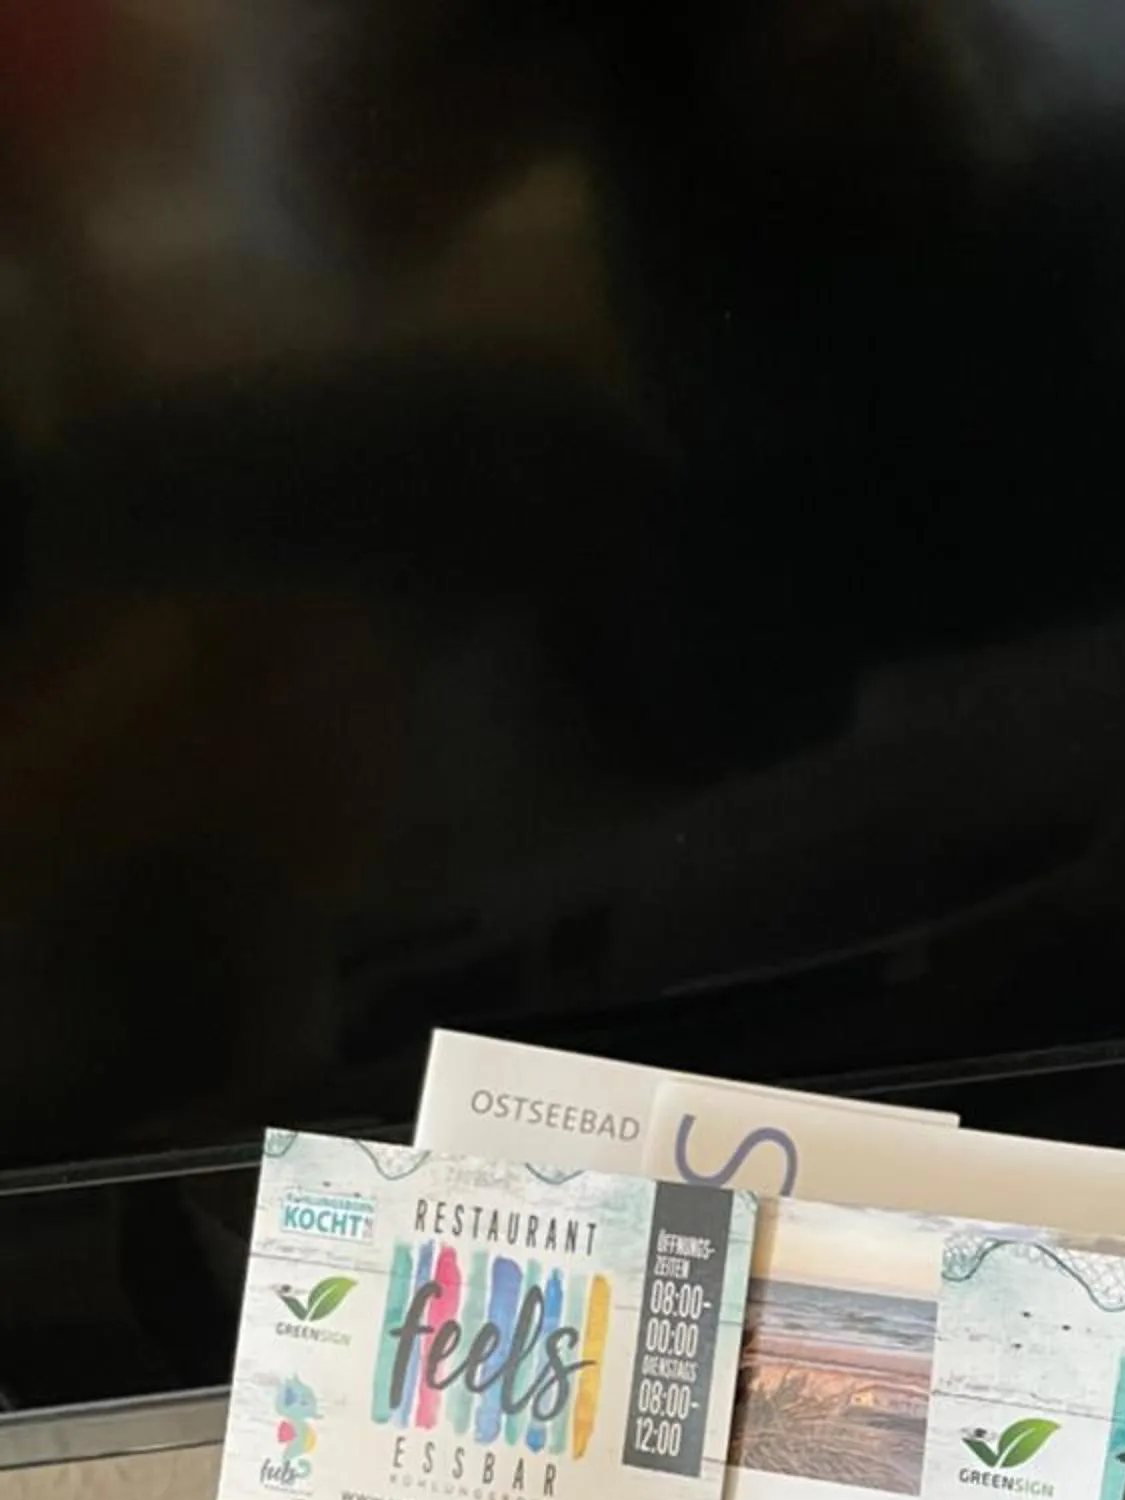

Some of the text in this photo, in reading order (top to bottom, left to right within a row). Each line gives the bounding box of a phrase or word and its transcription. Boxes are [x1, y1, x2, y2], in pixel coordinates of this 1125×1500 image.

[470, 1089, 641, 1142] OSTSEEBAD
[414, 1199, 598, 1257] RESTAURANT
[653, 1254, 691, 1279] ZEITEN
[650, 1279, 712, 1320] 08:00-
[275, 1321, 352, 1346] GREENSIGN
[389, 1279, 598, 1423] feels
[645, 1317, 699, 1358] 00:00
[641, 1355, 698, 1384] DIENSTAGS
[638, 1379, 700, 1421] 08:00-
[634, 1416, 682, 1457] 12:00
[392, 1436, 557, 1497] ESSBAR
[958, 1467, 1055, 1498] GREENSIGN
